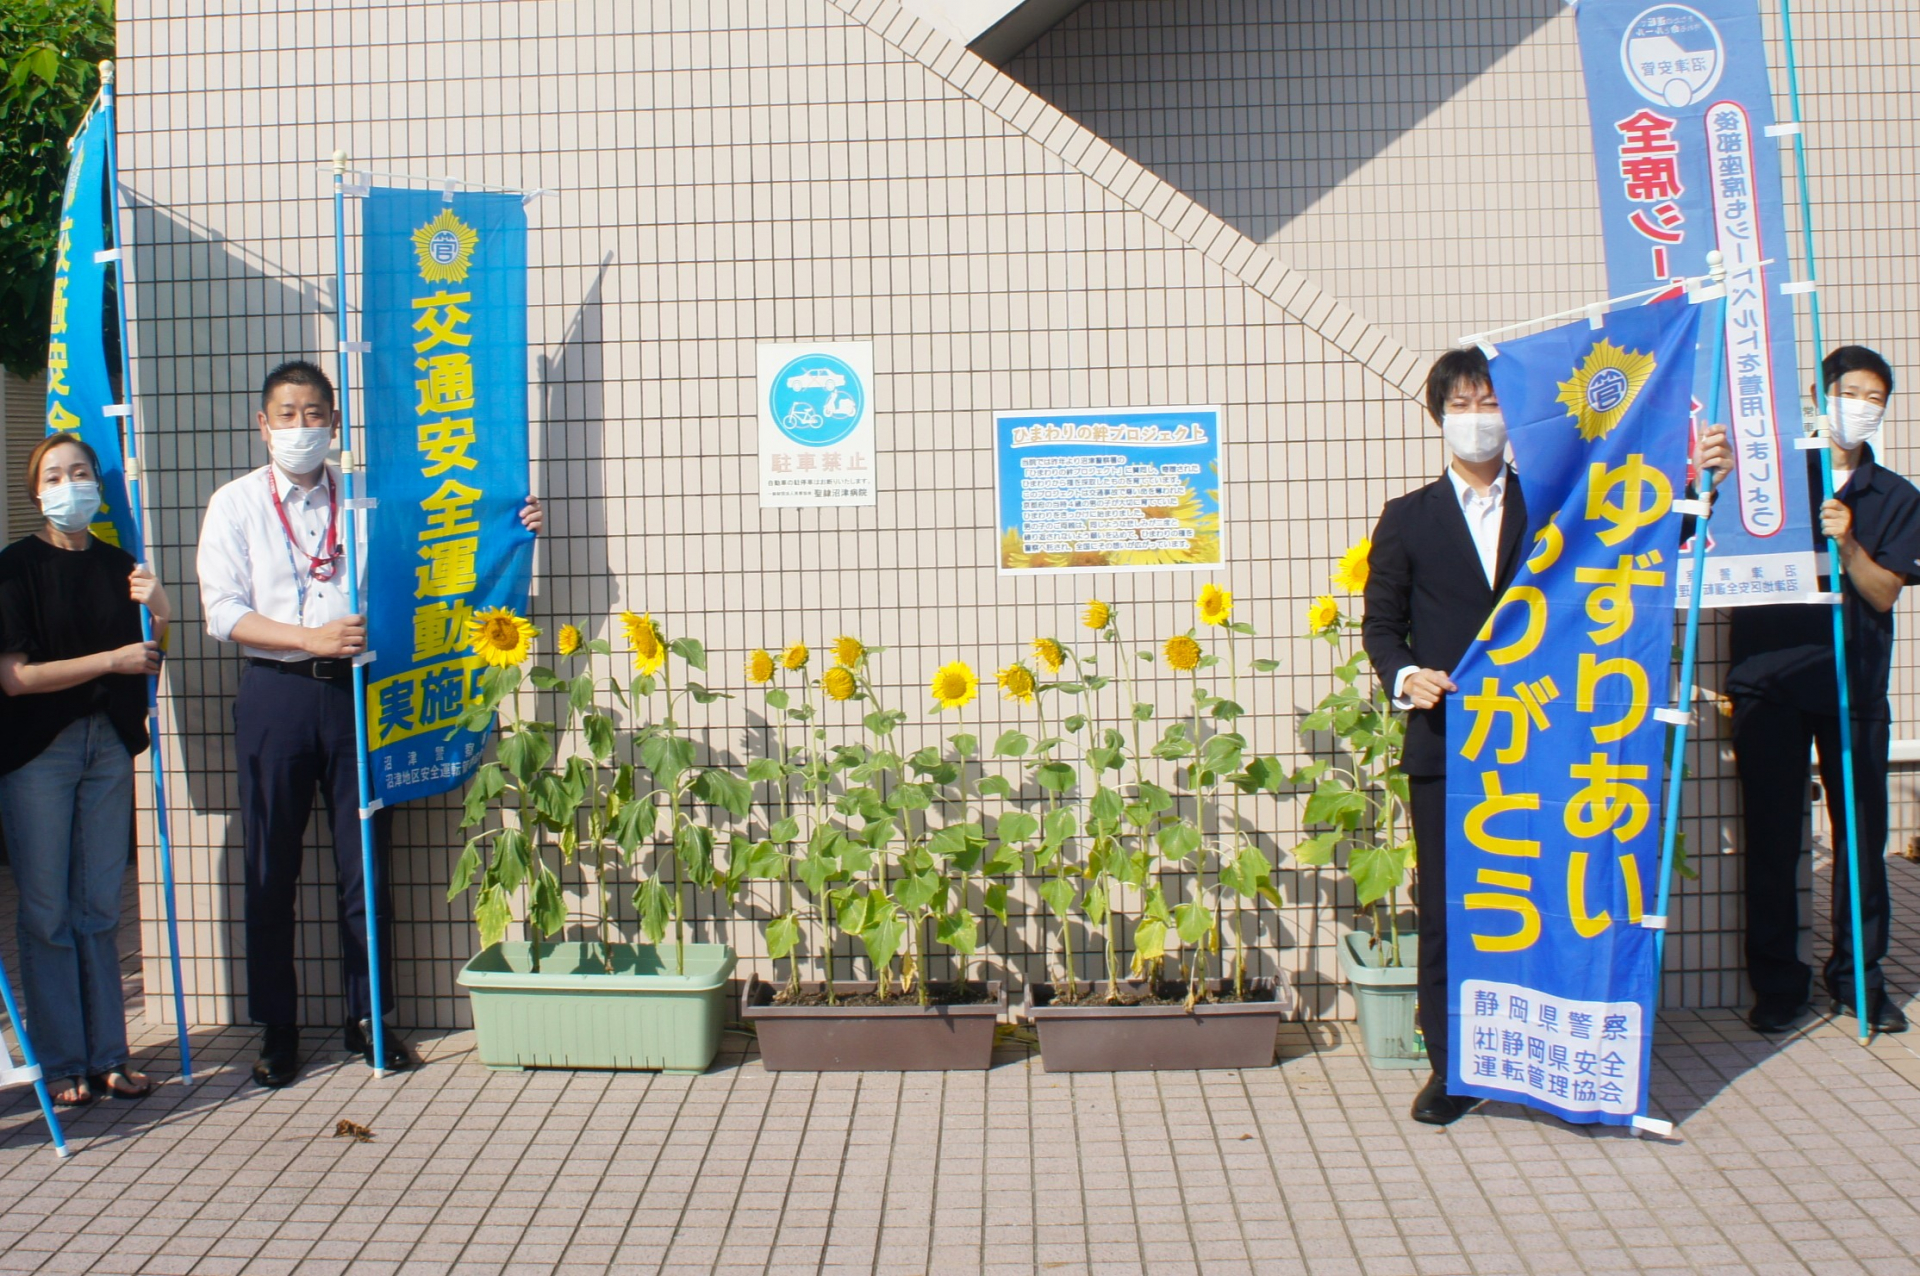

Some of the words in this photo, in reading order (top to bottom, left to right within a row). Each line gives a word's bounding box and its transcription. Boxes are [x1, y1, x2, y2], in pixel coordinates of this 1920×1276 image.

[1012, 424, 1205, 443] ひまわりの絆プロジェクト
[412, 290, 483, 662] 交通安全運動
[771, 451, 868, 473] 駐車禁止
[1563, 454, 1673, 938] ゆずりあい
[1474, 990, 1628, 1041] 静岡県警察
[1473, 1054, 1624, 1105] 運転管理協会
